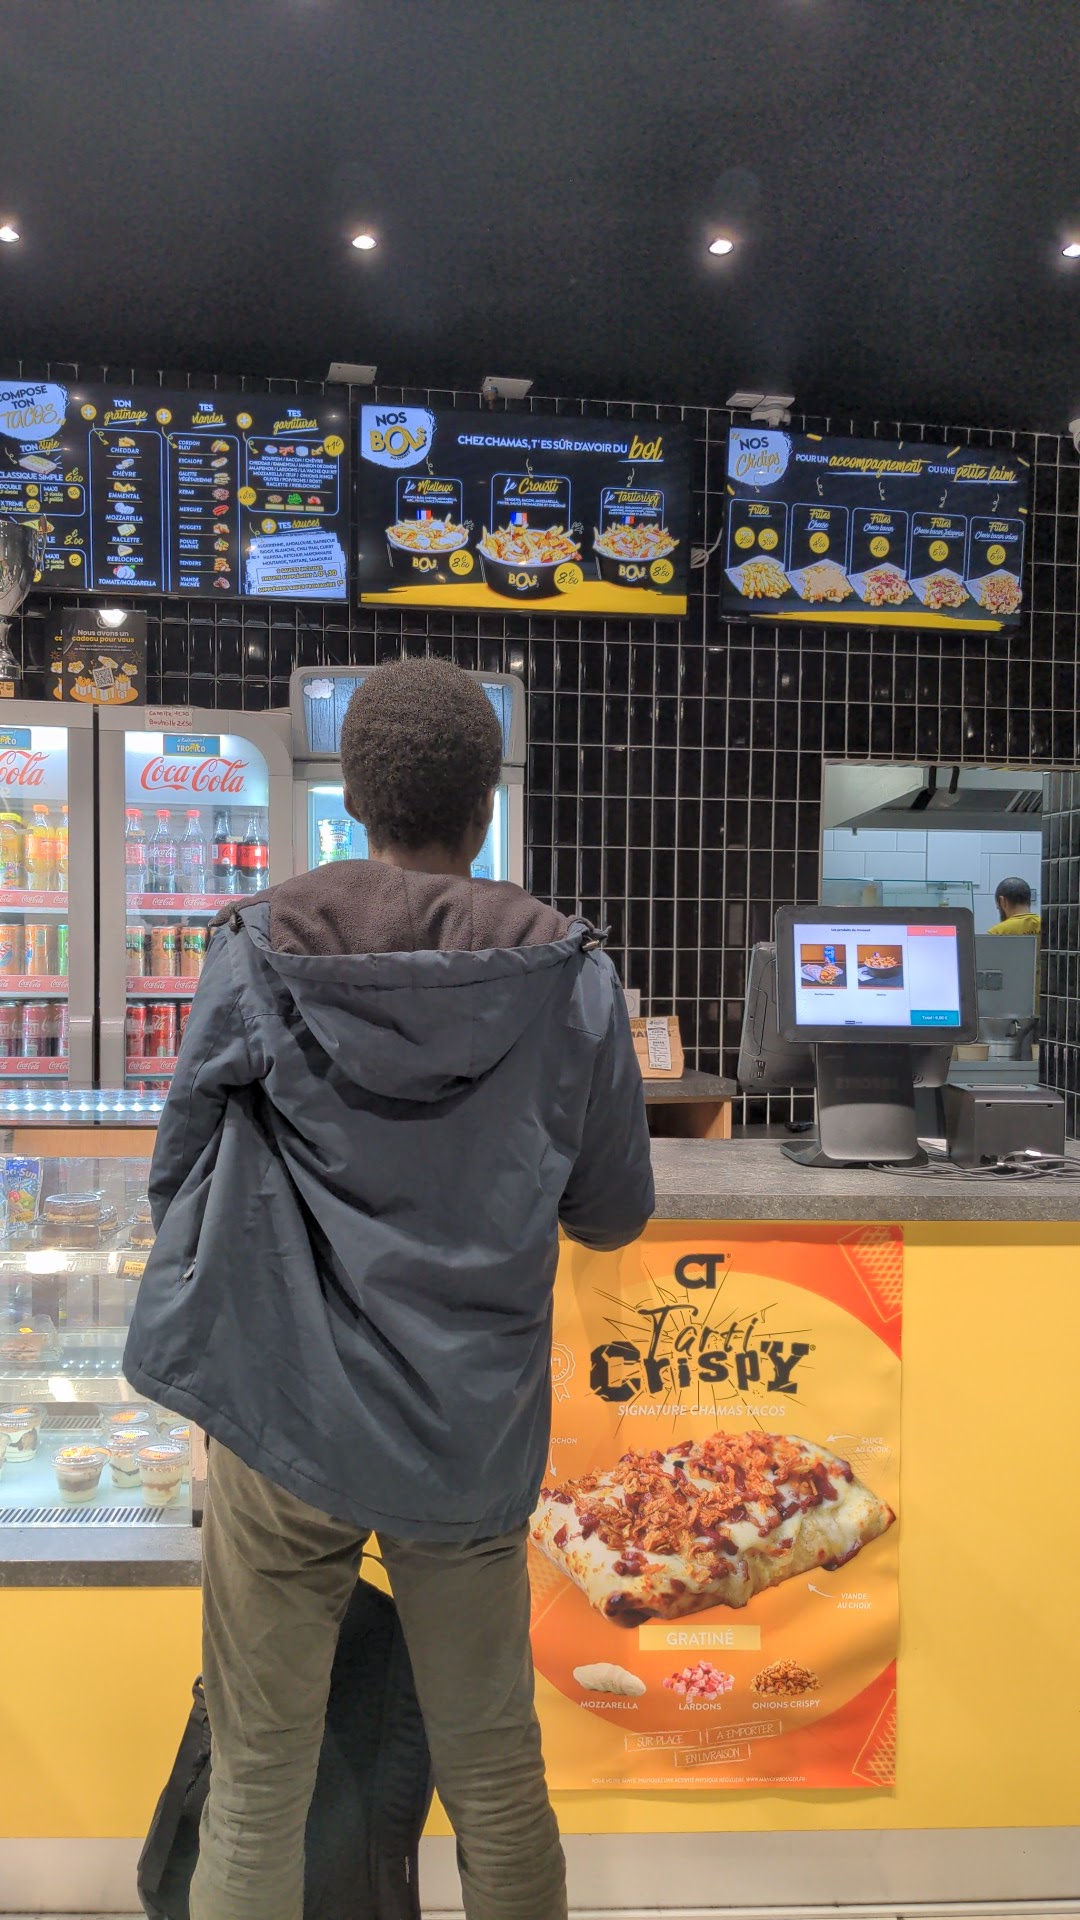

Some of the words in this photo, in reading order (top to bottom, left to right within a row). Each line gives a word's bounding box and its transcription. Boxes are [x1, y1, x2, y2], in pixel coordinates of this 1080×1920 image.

[11, 398, 36, 410] TON
[113, 400, 132, 408] TON
[198, 403, 214, 412] TES
[104, 408, 148, 427] gratinage
[192, 412, 225, 424] viandes
[287, 410, 302, 418] TES
[375, 412, 407, 427] NOS
[273, 418, 318, 436] garnitures
[20, 444, 39, 453] TON
[110, 446, 140, 454] CHEDDAR
[457, 435, 485, 445] CHEZ
[485, 438, 531, 451] CHAMAS,
[553, 438, 573, 450] SÛR
[613, 444, 628, 454] DU
[628, 435, 664, 460] bol
[740, 437, 769, 451] NOS
[796, 454, 816, 462] POUR
[817, 455, 829, 463] UN
[828, 455, 932, 478] accompagnement
[928, 465, 940, 473] OU
[940, 466, 955, 475] UNE
[954, 464, 990, 482] petite
[39, 473, 64, 481] SIMPLE
[518, 477, 563, 494] Crousti
[108, 492, 140, 500] EMMENTAL
[748, 504, 770, 516] Frites
[809, 508, 831, 520] Frites
[105, 514, 144, 522] MOZZARELLA
[870, 513, 891, 524] Frites
[931, 517, 952, 529] Frites
[988, 521, 1009, 533] Frites
[112, 536, 140, 544] RACLETTE
[100, 636, 117, 644] pour
[140, 756, 249, 793] Coca-Cola
[674, 1253, 725, 1289] CT
[635, 1303, 760, 1356] Tarti
[618, 1404, 687, 1417] SIGNATURE
[690, 1405, 742, 1417] CHAMAS
[746, 1405, 786, 1418] TACOS
[840, 1592, 868, 1600] VIANDE
[837, 1602, 850, 1610] AU
[852, 1601, 872, 1610] CHOIX
[666, 1629, 735, 1647] GRATINÉ
[580, 1701, 639, 1710] MOZZARELLA
[678, 1702, 722, 1711] LARDONS
[752, 1700, 788, 1710] ONIONS
[790, 1699, 821, 1709] CRISPY
[726, 1723, 774, 1739] EMPORTER
[636, 1735, 655, 1747] SUR
[656, 1734, 684, 1745] PLACE
[685, 1752, 699, 1764] EN
[699, 1747, 741, 1763] LIVRAISON
